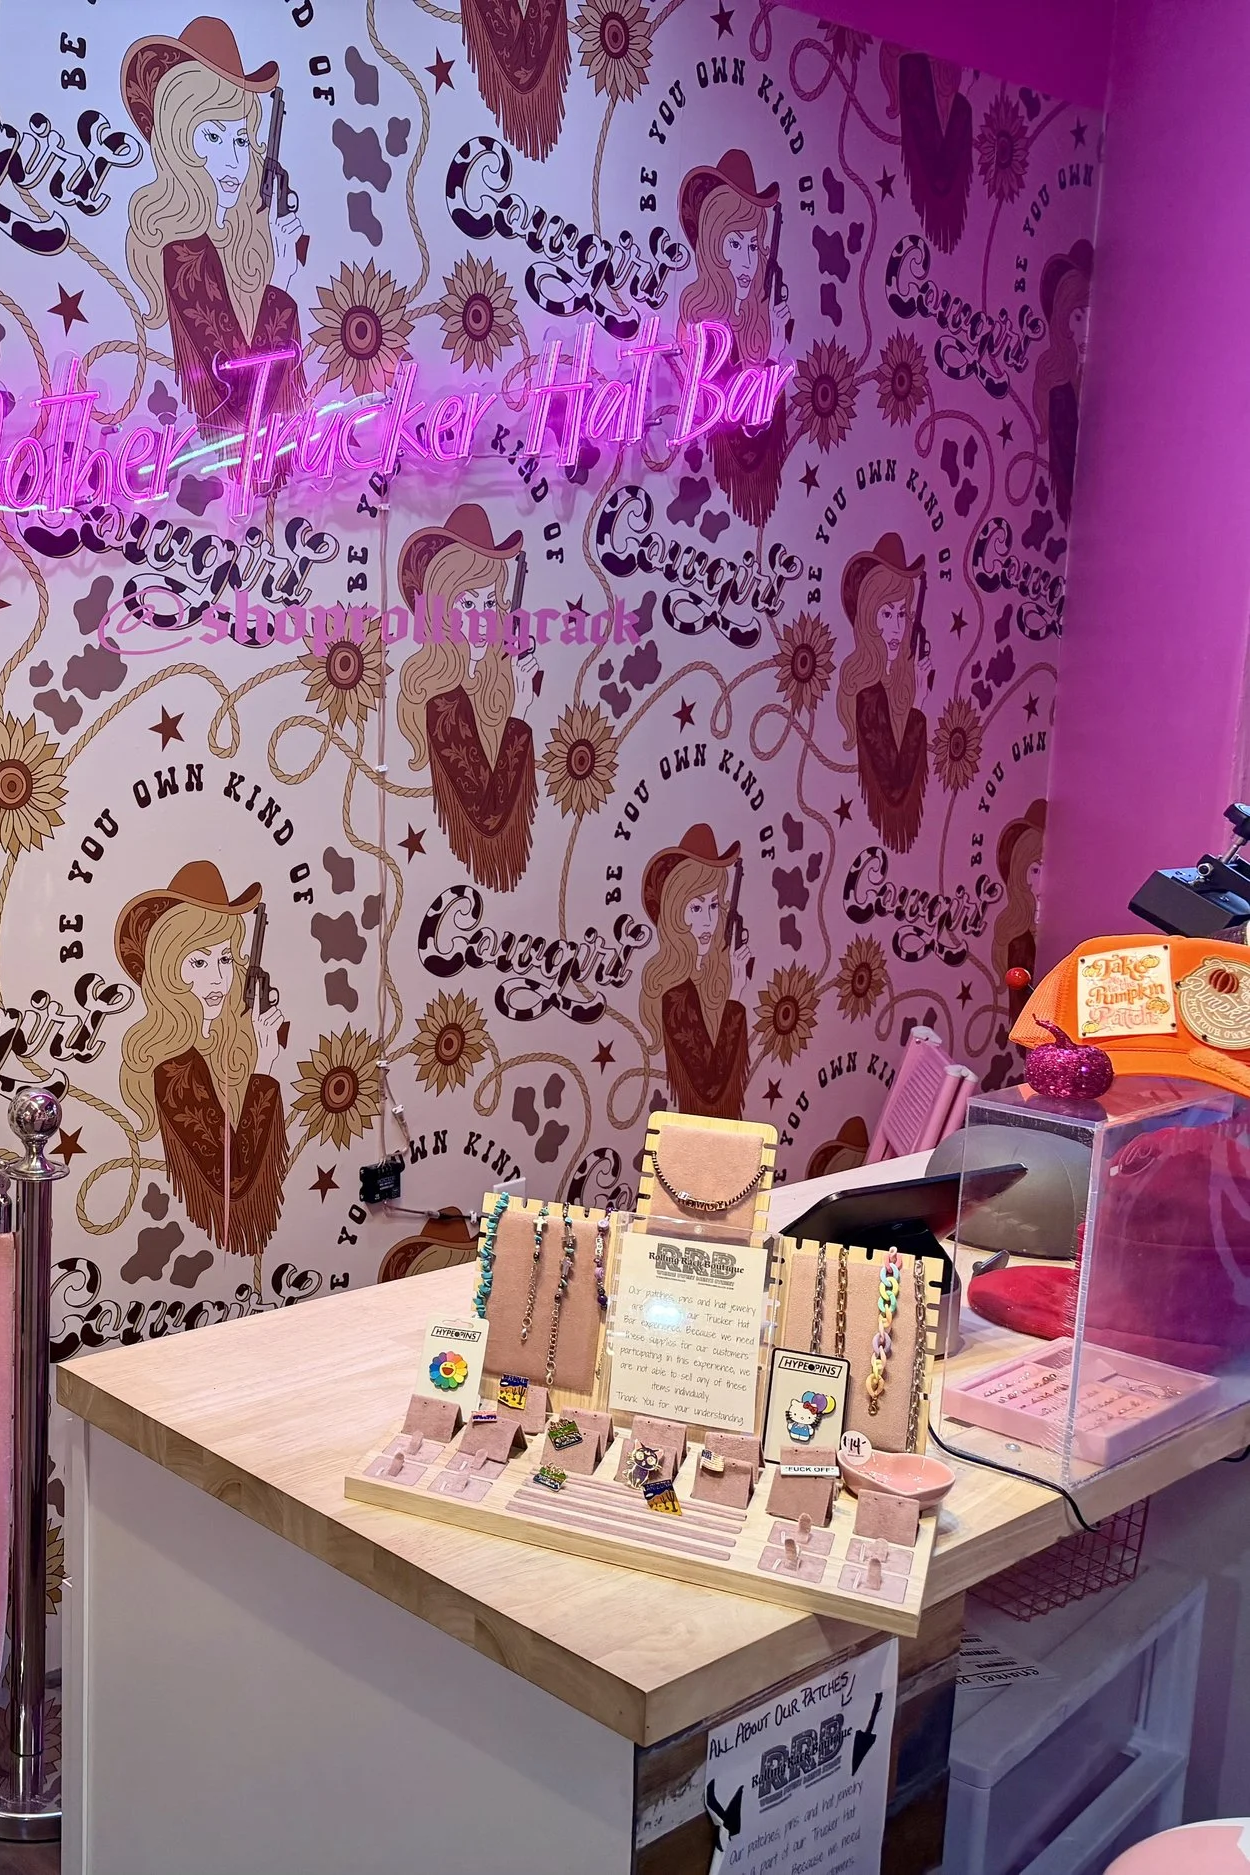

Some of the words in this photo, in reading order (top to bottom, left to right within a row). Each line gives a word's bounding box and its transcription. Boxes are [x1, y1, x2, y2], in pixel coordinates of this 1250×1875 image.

[60, 32, 87, 90] BE
[309, 55, 335, 106] OF
[640, 167, 658, 212] BE
[649, 79, 686, 144] YOU
[696, 56, 746, 89] OWN
[758, 73, 804, 155] KIND
[798, 175, 815, 216] OF
[445, 136, 691, 341] Cowgirl
[1022, 184, 1051, 238] YOU
[1057, 163, 1094, 190] OWN
[885, 234, 1047, 399] Cowgirl
[218, 350, 498, 518] Trucker
[524, 316, 675, 467] Hat
[666, 320, 795, 448] Bar
[347, 546, 369, 593] BE
[543, 522, 564, 563] OF
[596, 485, 804, 650] Cowgirl
[807, 565, 823, 605] BE
[815, 486, 848, 545] YOU
[856, 459, 898, 491] OWN
[905, 468, 946, 533] KIND
[938, 547, 952, 582] OF
[132, 763, 204, 808] OWN
[223, 771, 296, 847] KIND
[605, 865, 623, 905] BE
[614, 780, 650, 841] YOU
[659, 743, 707, 780] OWN
[718, 749, 766, 811] KIND
[759, 825, 775, 859] OF
[970, 833, 984, 868] BE
[977, 761, 1006, 814] YOU
[1011, 731, 1047, 763] OWN
[68, 809, 120, 884] YOU
[290, 863, 314, 905] OF
[59, 914, 84, 963] BE
[843, 846, 1004, 967] Cowgirl
[418, 885, 652, 1024] Cowgirl
[779, 1091, 810, 1147] YOU
[817, 1051, 858, 1089] OWN
[866, 1053, 897, 1092] KIN
[708, 1738, 734, 1761] ALL
[735, 1711, 771, 1749] ABOUT
[774, 1698, 801, 1727] OUR
[800, 1670, 850, 1708] PATCHES
